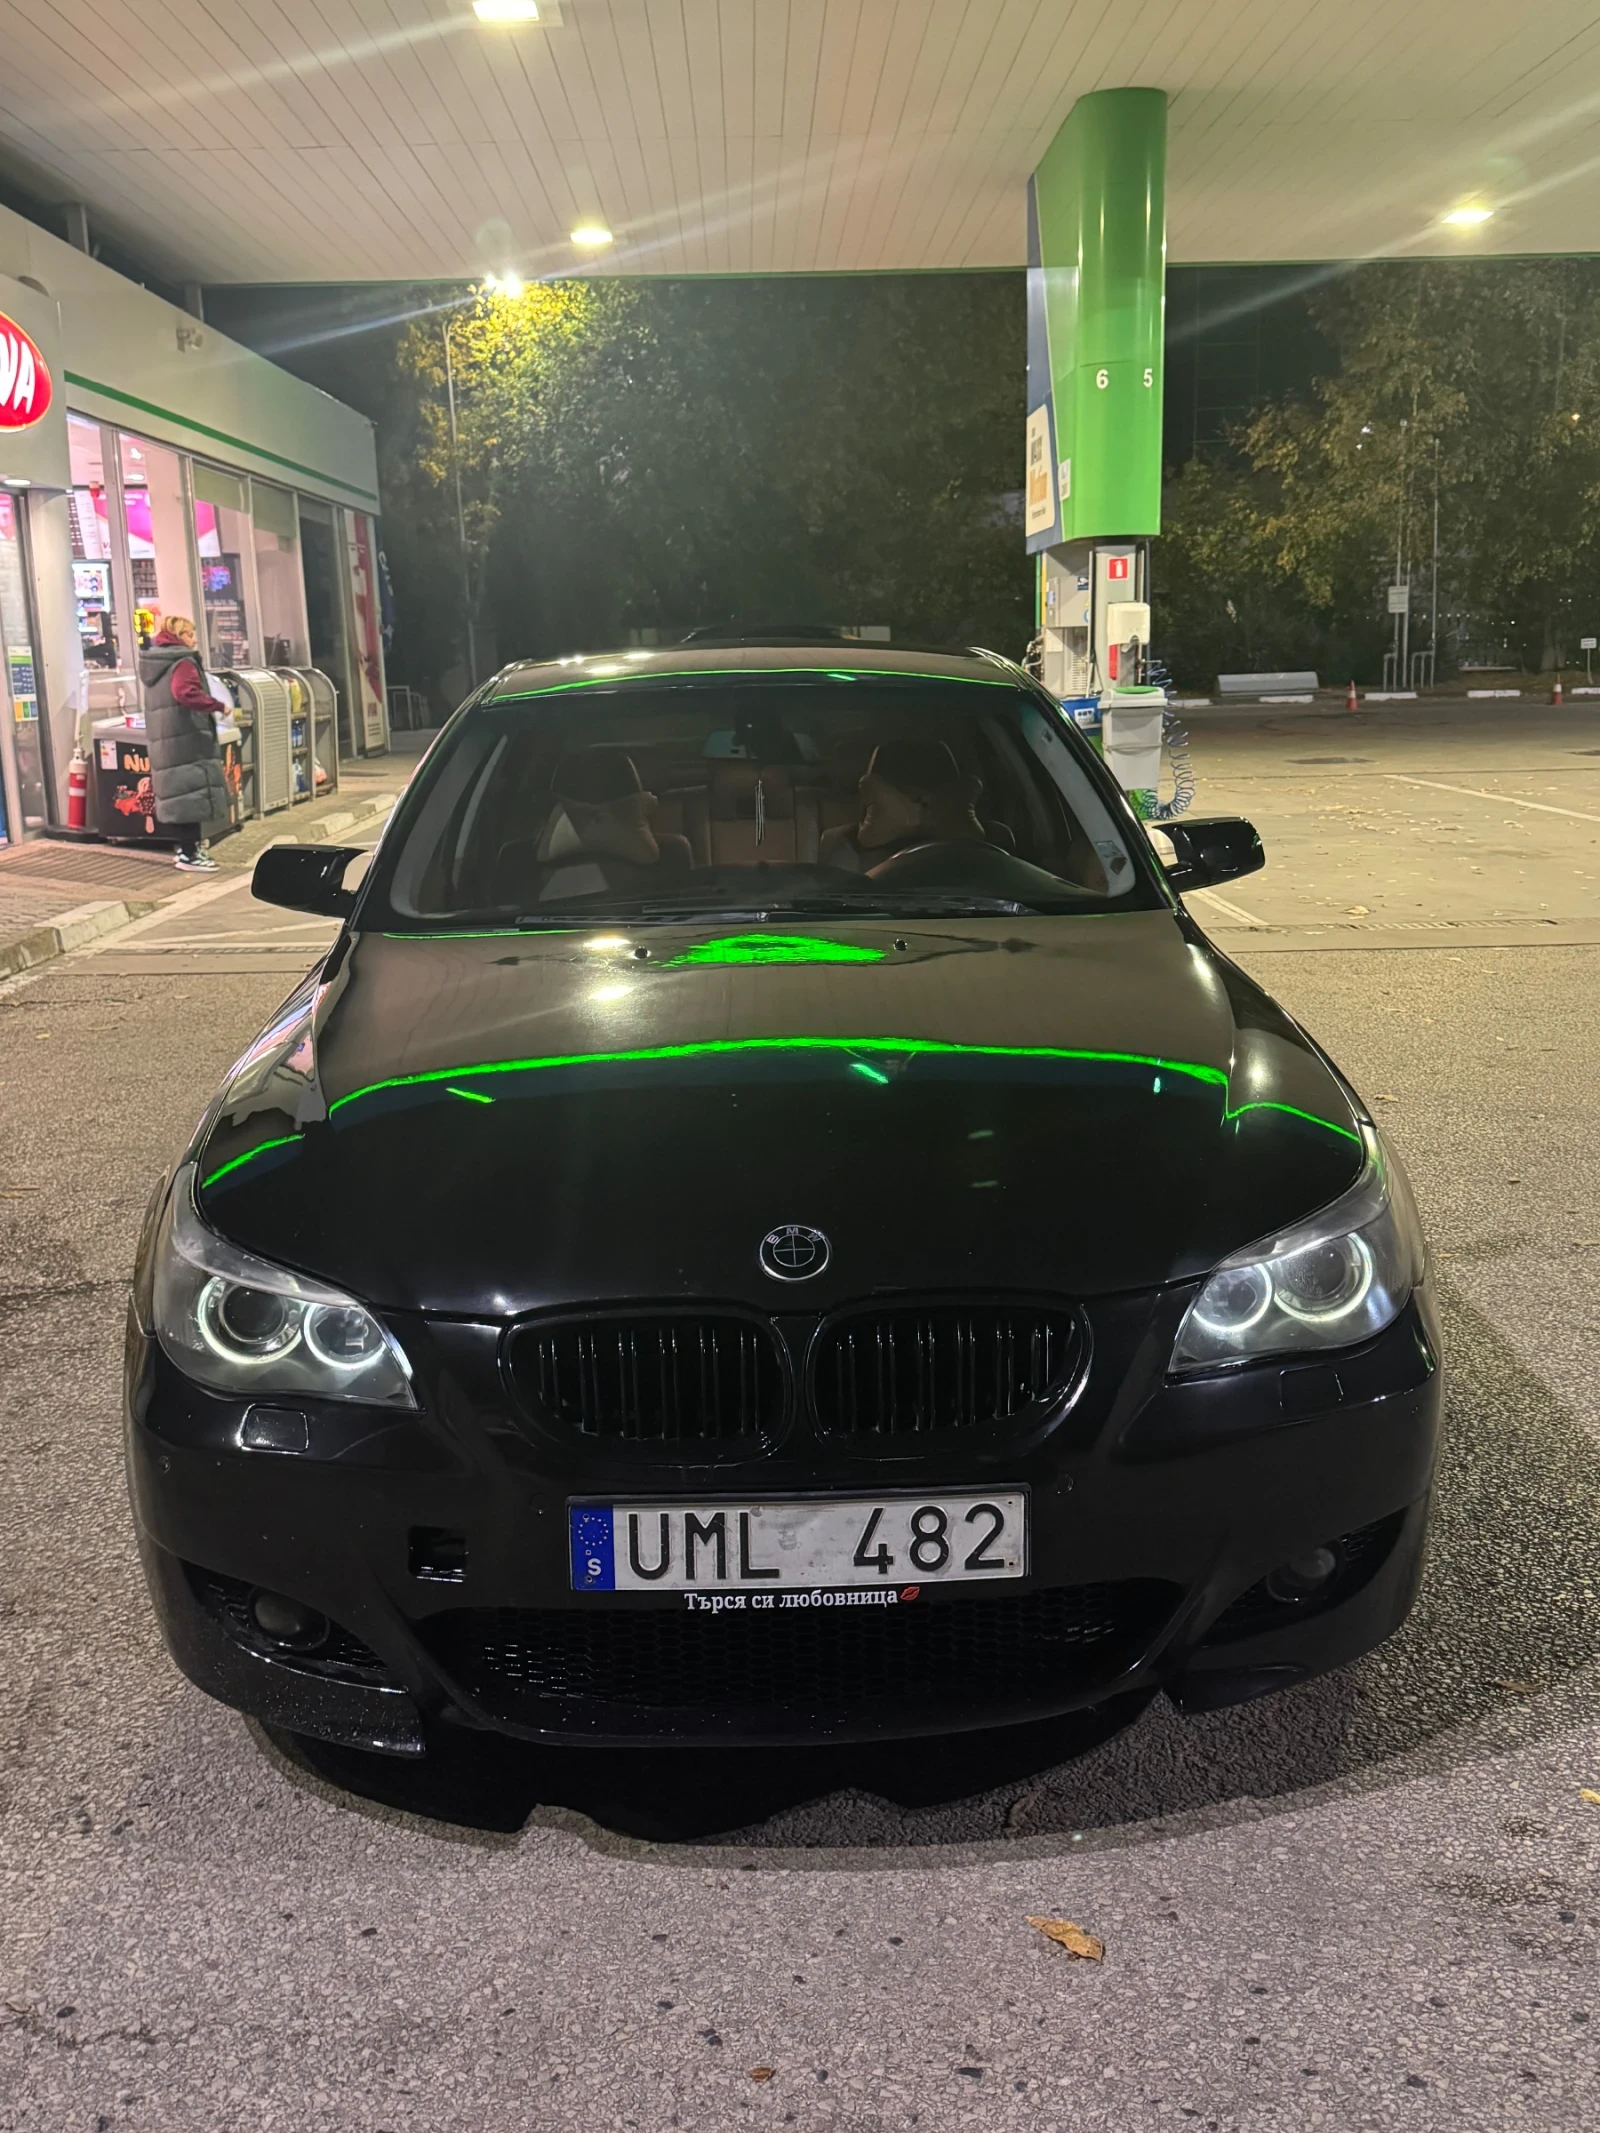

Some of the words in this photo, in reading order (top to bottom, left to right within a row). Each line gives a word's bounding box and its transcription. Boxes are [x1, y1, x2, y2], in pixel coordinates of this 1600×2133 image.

[1096, 369, 1109, 389] 6
[1143, 368, 1153, 388] 5
[766, 1227, 821, 1244] BMW
[627, 1511, 780, 1580] UML
[853, 1503, 1005, 1574] 482
[587, 1558, 602, 1576] S
[684, 1593, 747, 1614] Търся
[751, 1594, 775, 1609] си
[779, 1589, 899, 1608] любовница
